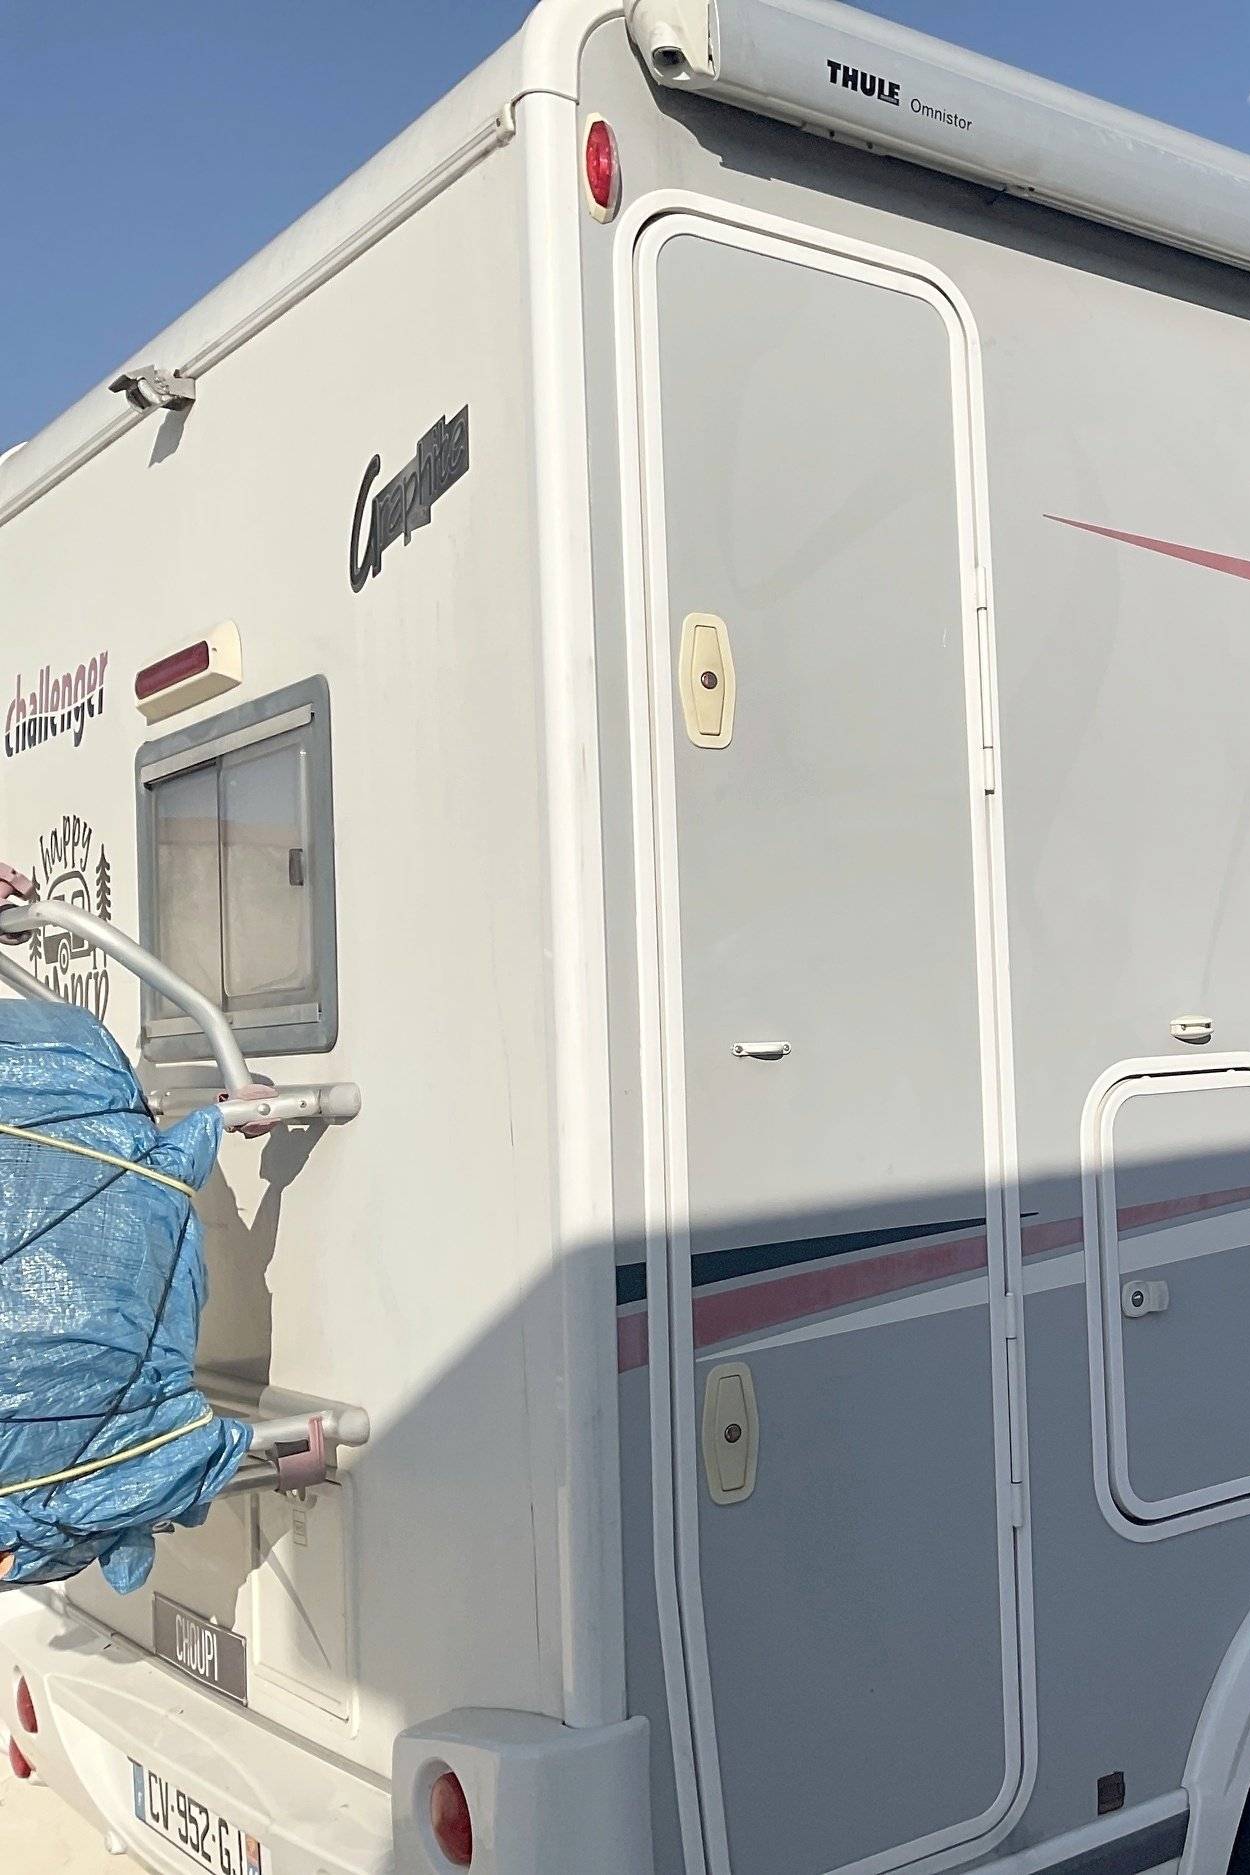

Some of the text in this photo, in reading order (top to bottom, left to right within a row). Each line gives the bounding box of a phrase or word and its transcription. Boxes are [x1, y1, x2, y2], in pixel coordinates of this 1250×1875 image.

[827, 59, 973, 131] THULE Omnistor
[350, 405, 469, 593] Graphite
[39, 814, 92, 884] happy
[174, 1613, 219, 1681] CHOUPI
